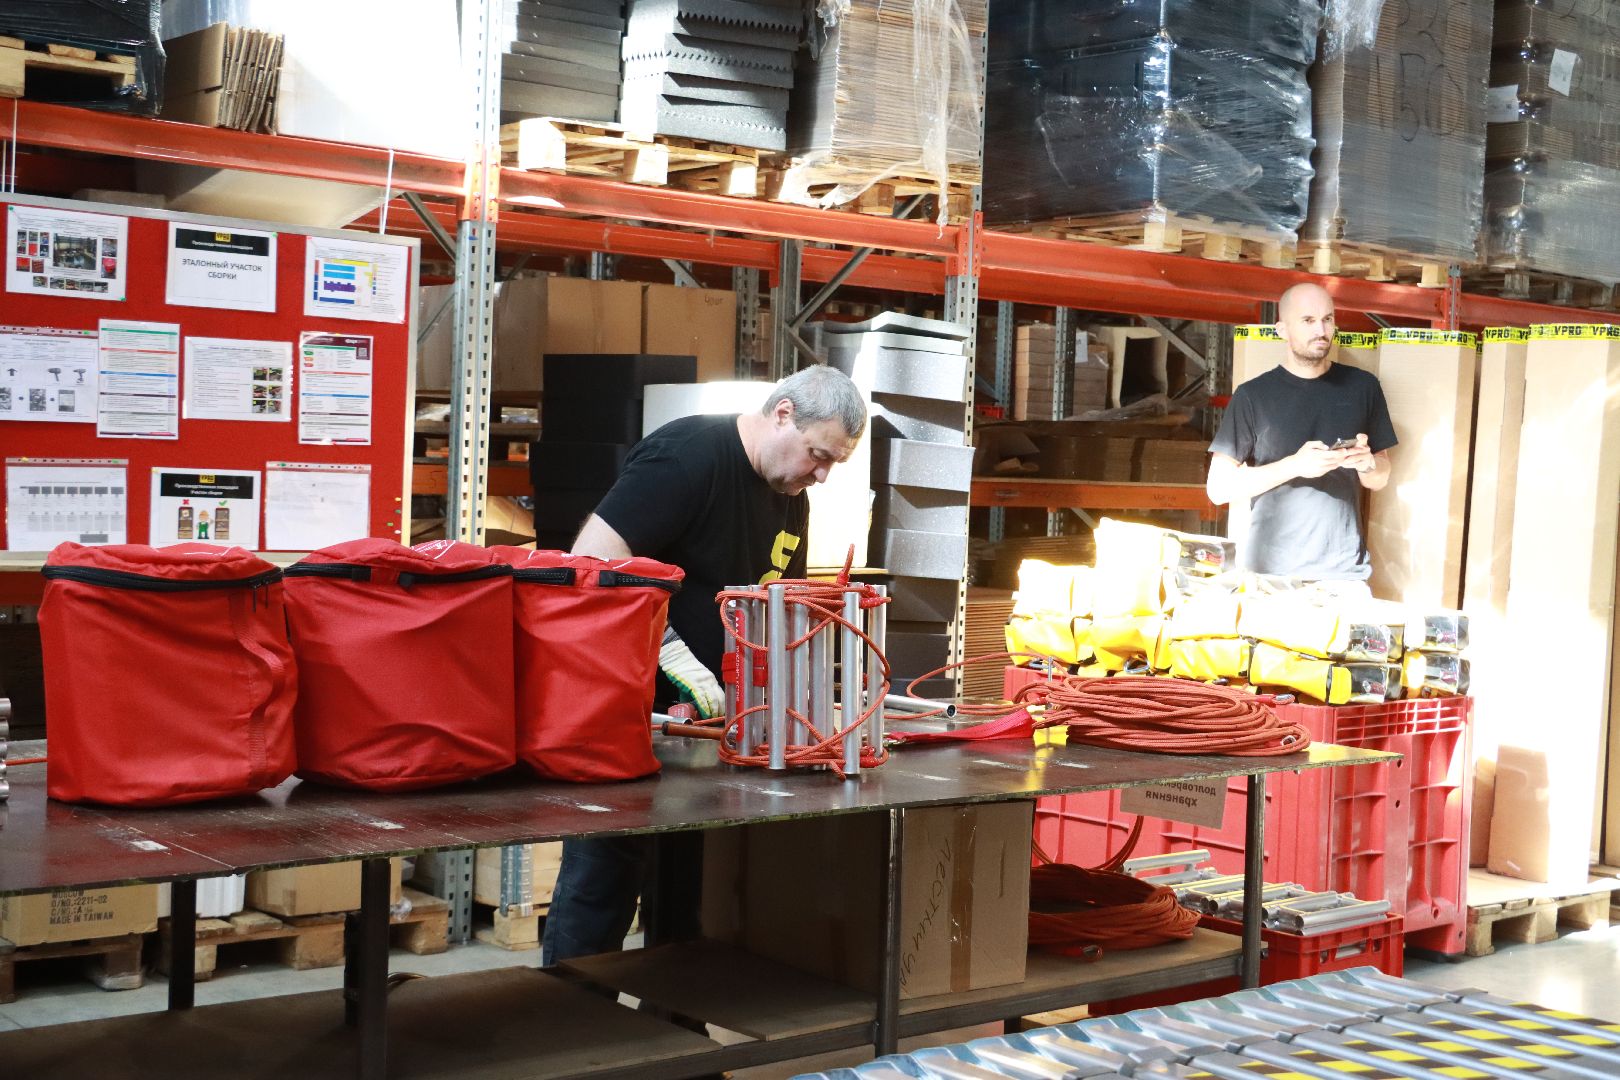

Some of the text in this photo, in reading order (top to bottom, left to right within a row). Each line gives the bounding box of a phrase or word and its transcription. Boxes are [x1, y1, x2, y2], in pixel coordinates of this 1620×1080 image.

[182, 259, 262, 272] ЭТАЛОННЫЙ УЧАСТОК
[208, 272, 236, 280] СБОРКИ
[1555, 326, 1581, 335] VPRO
[50, 915, 71, 924] MADE
[84, 912, 113, 921] TAIWAN
